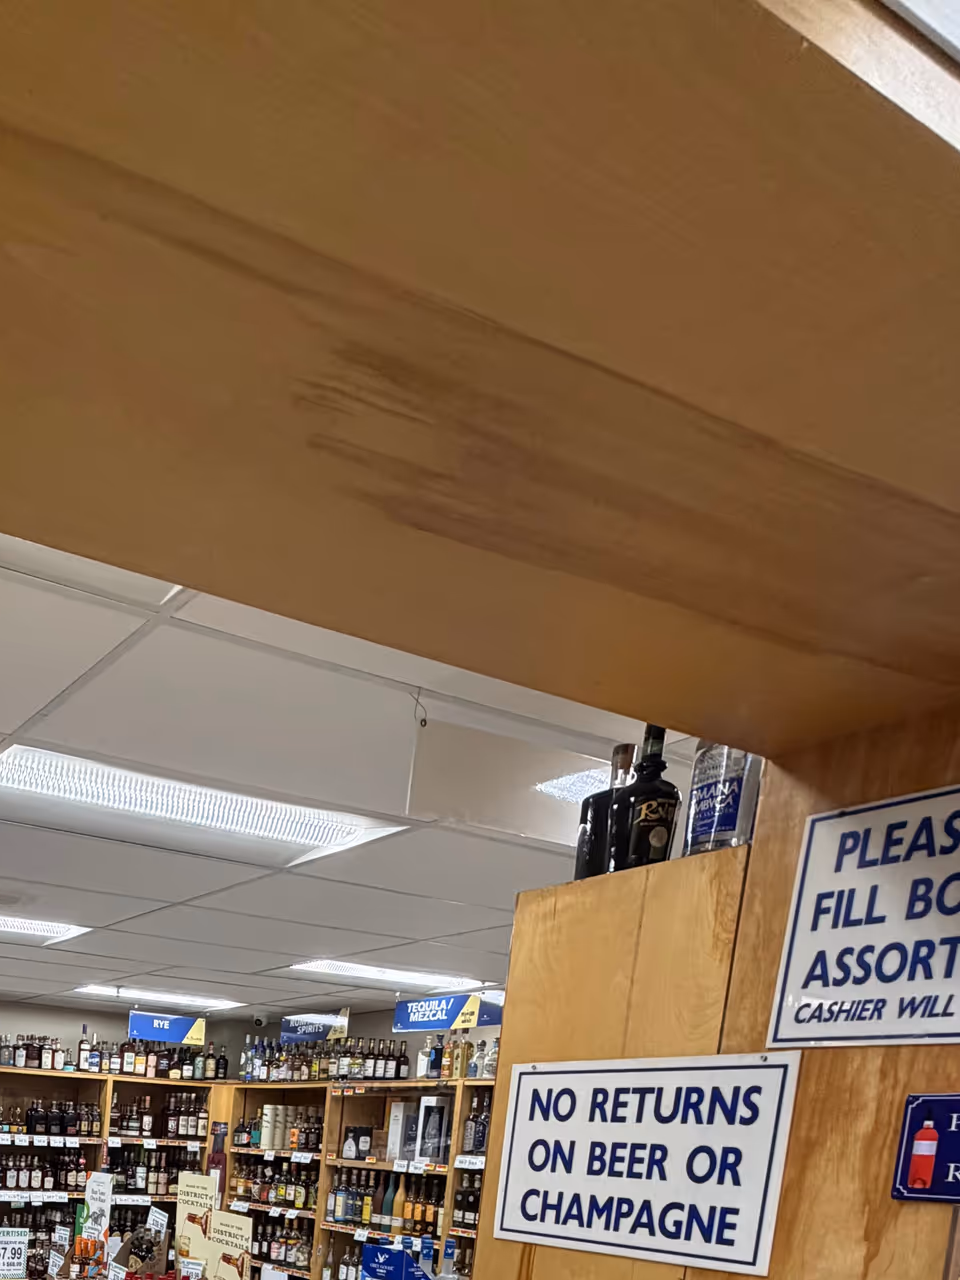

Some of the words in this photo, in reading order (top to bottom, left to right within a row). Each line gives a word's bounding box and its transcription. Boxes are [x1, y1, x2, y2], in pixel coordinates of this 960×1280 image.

[835, 809, 960, 873] PLEAS
[811, 885, 886, 931] FILL
[801, 936, 960, 989] ASSORT
[409, 1009, 448, 1022] MEZCAL
[794, 998, 886, 1023] CASHIER
[897, 994, 955, 1019] WILL
[153, 1019, 169, 1029] RYE
[297, 1023, 323, 1035] SPIRITS
[528, 1087, 575, 1123] NO
[588, 1085, 763, 1127] RETURNS
[528, 1140, 575, 1175] ON
[587, 1142, 668, 1181] BEER
[686, 1146, 743, 1186] OR
[179, 1199, 213, 1209] COCKTAILS
[180, 1190, 208, 1200] DISTRICT
[520, 1189, 741, 1248] CHAMPAGNE
[212, 1237, 249, 1250] COCKTAILS
[213, 1228, 243, 1241] DISTRICT
